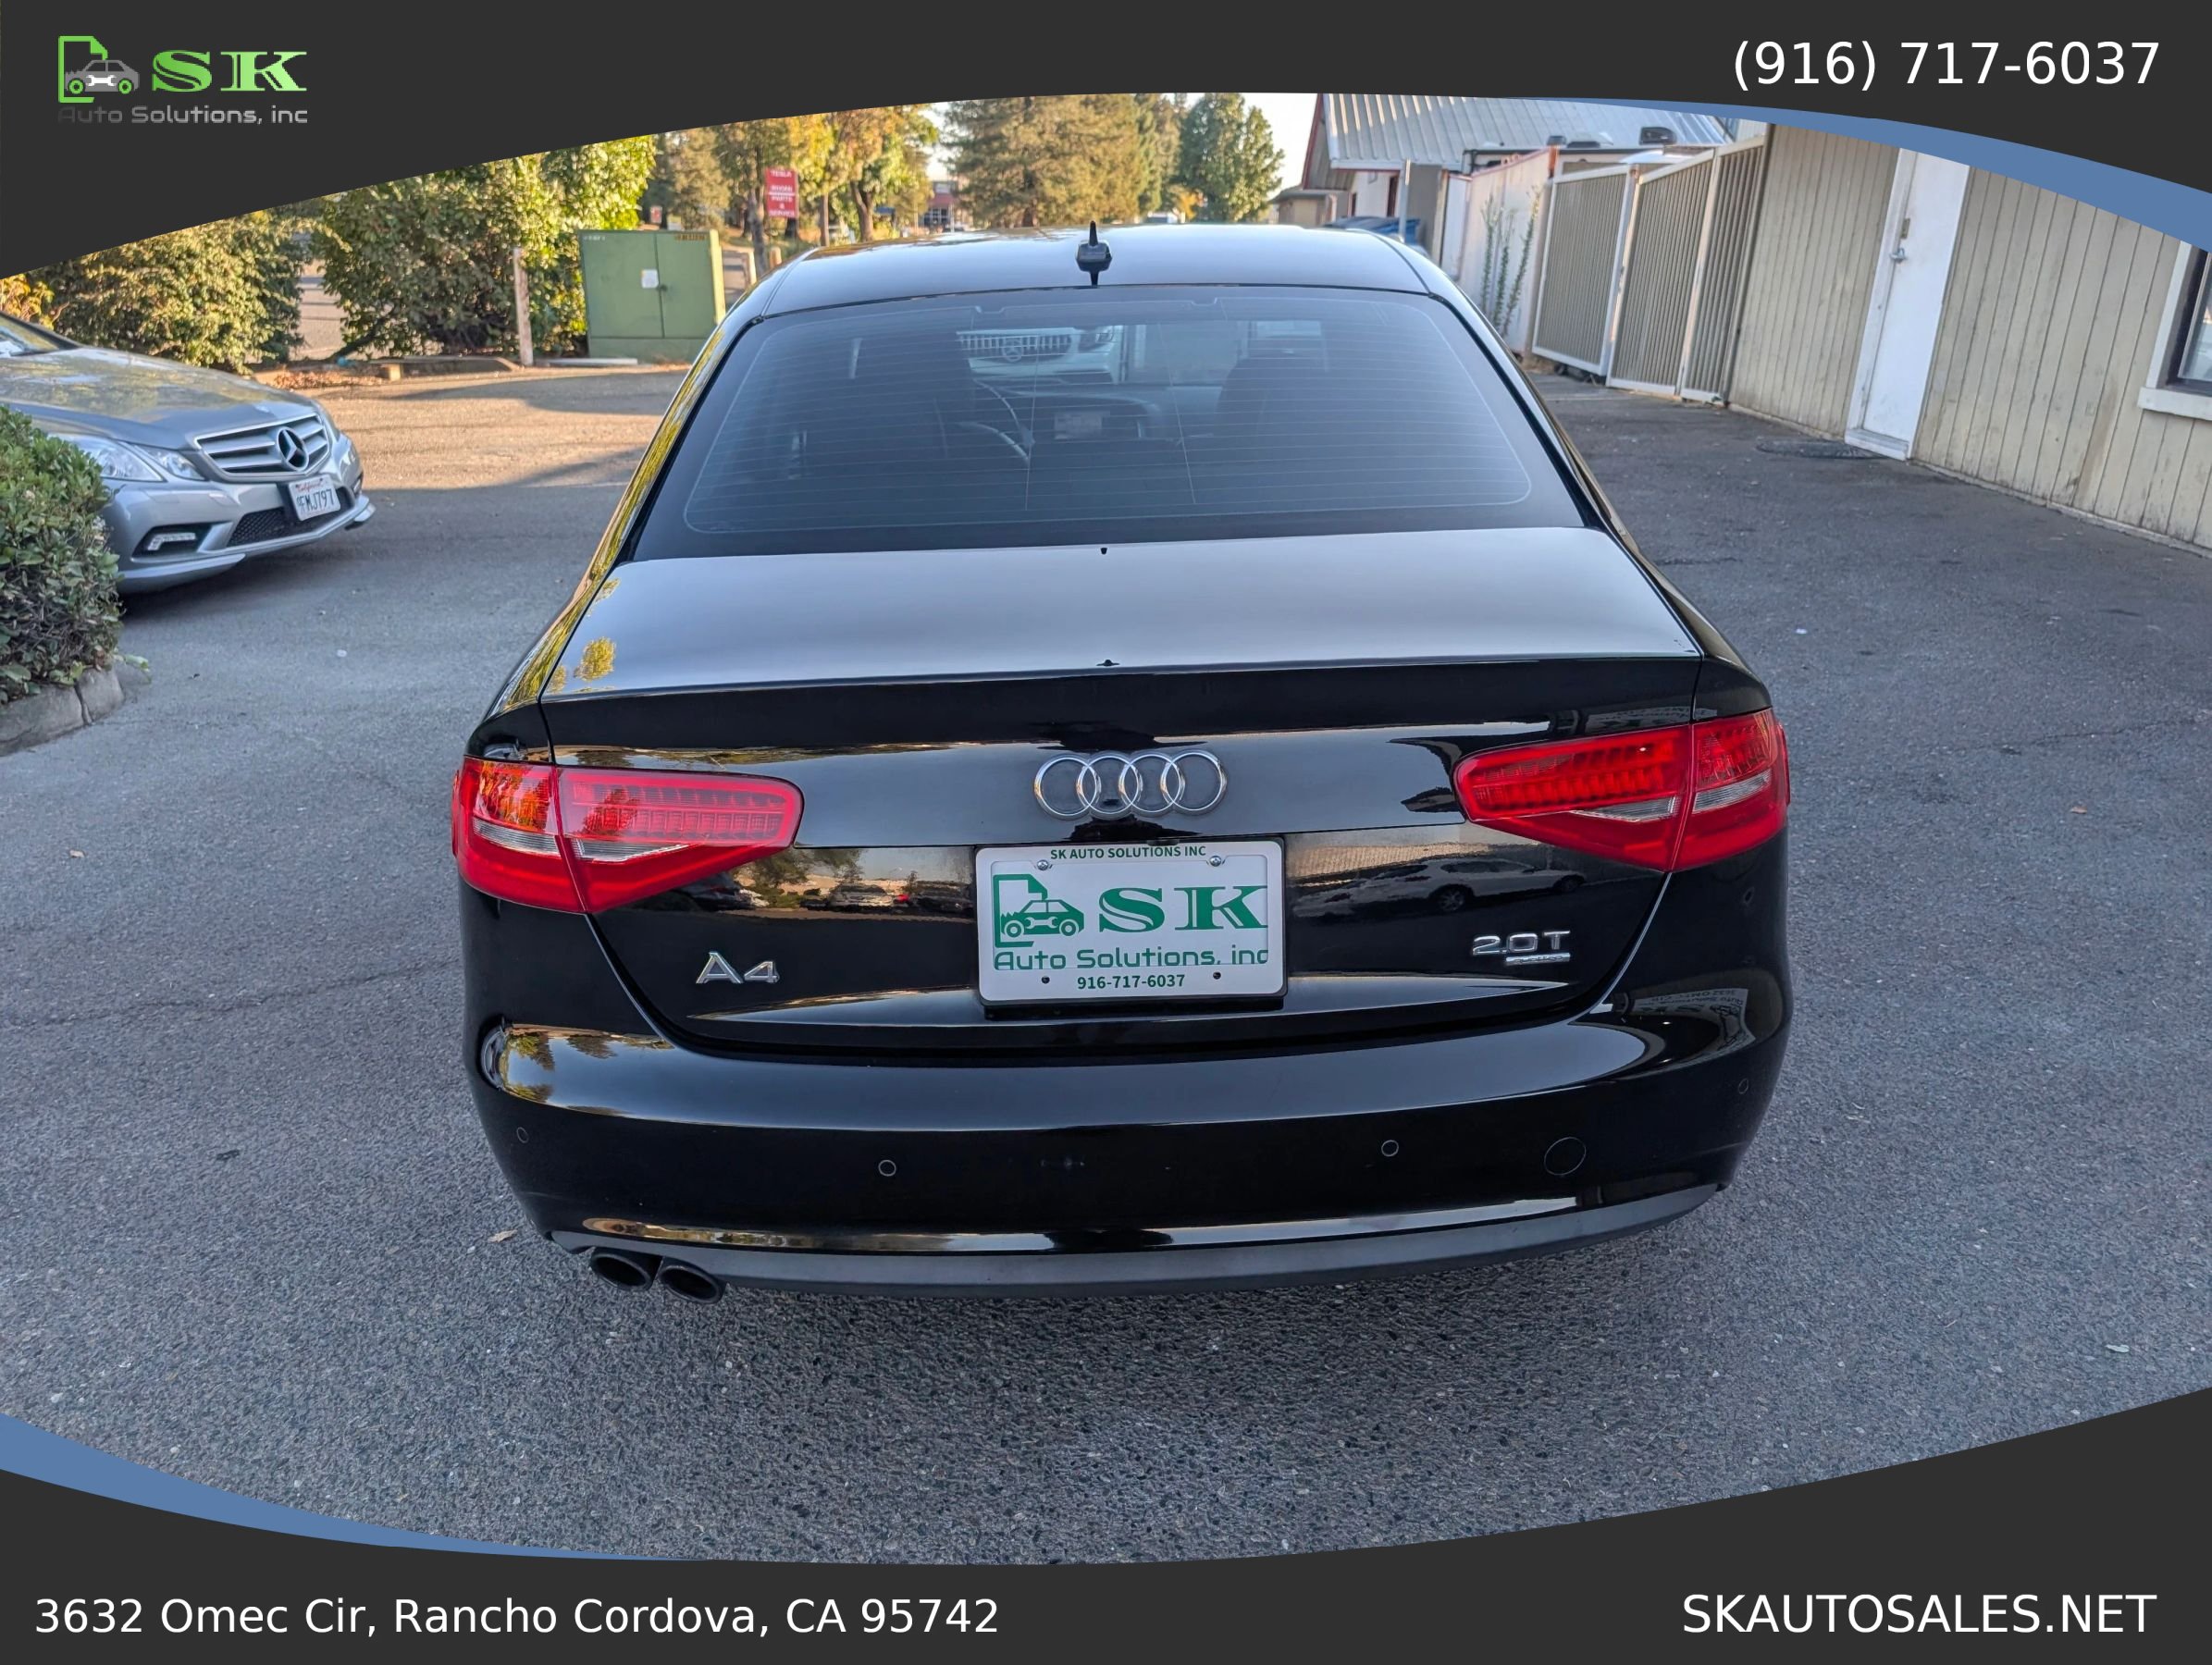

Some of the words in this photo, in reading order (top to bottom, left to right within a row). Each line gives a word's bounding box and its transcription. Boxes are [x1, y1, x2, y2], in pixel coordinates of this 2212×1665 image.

[1050, 849, 1067, 859] SK
[1069, 847, 1105, 859] AUTO
[1107, 846, 1181, 858] SOLUTIONS
[1184, 845, 1206, 857] INC
[1098, 885, 1268, 933] SK
[1472, 931, 1571, 956] 2.0T
[695, 951, 780, 984] A4
[994, 949, 1067, 970] Auto
[1076, 945, 1221, 969] Solutions,
[1231, 944, 1268, 965] inc
[1077, 974, 1185, 990] 916-717-6037
